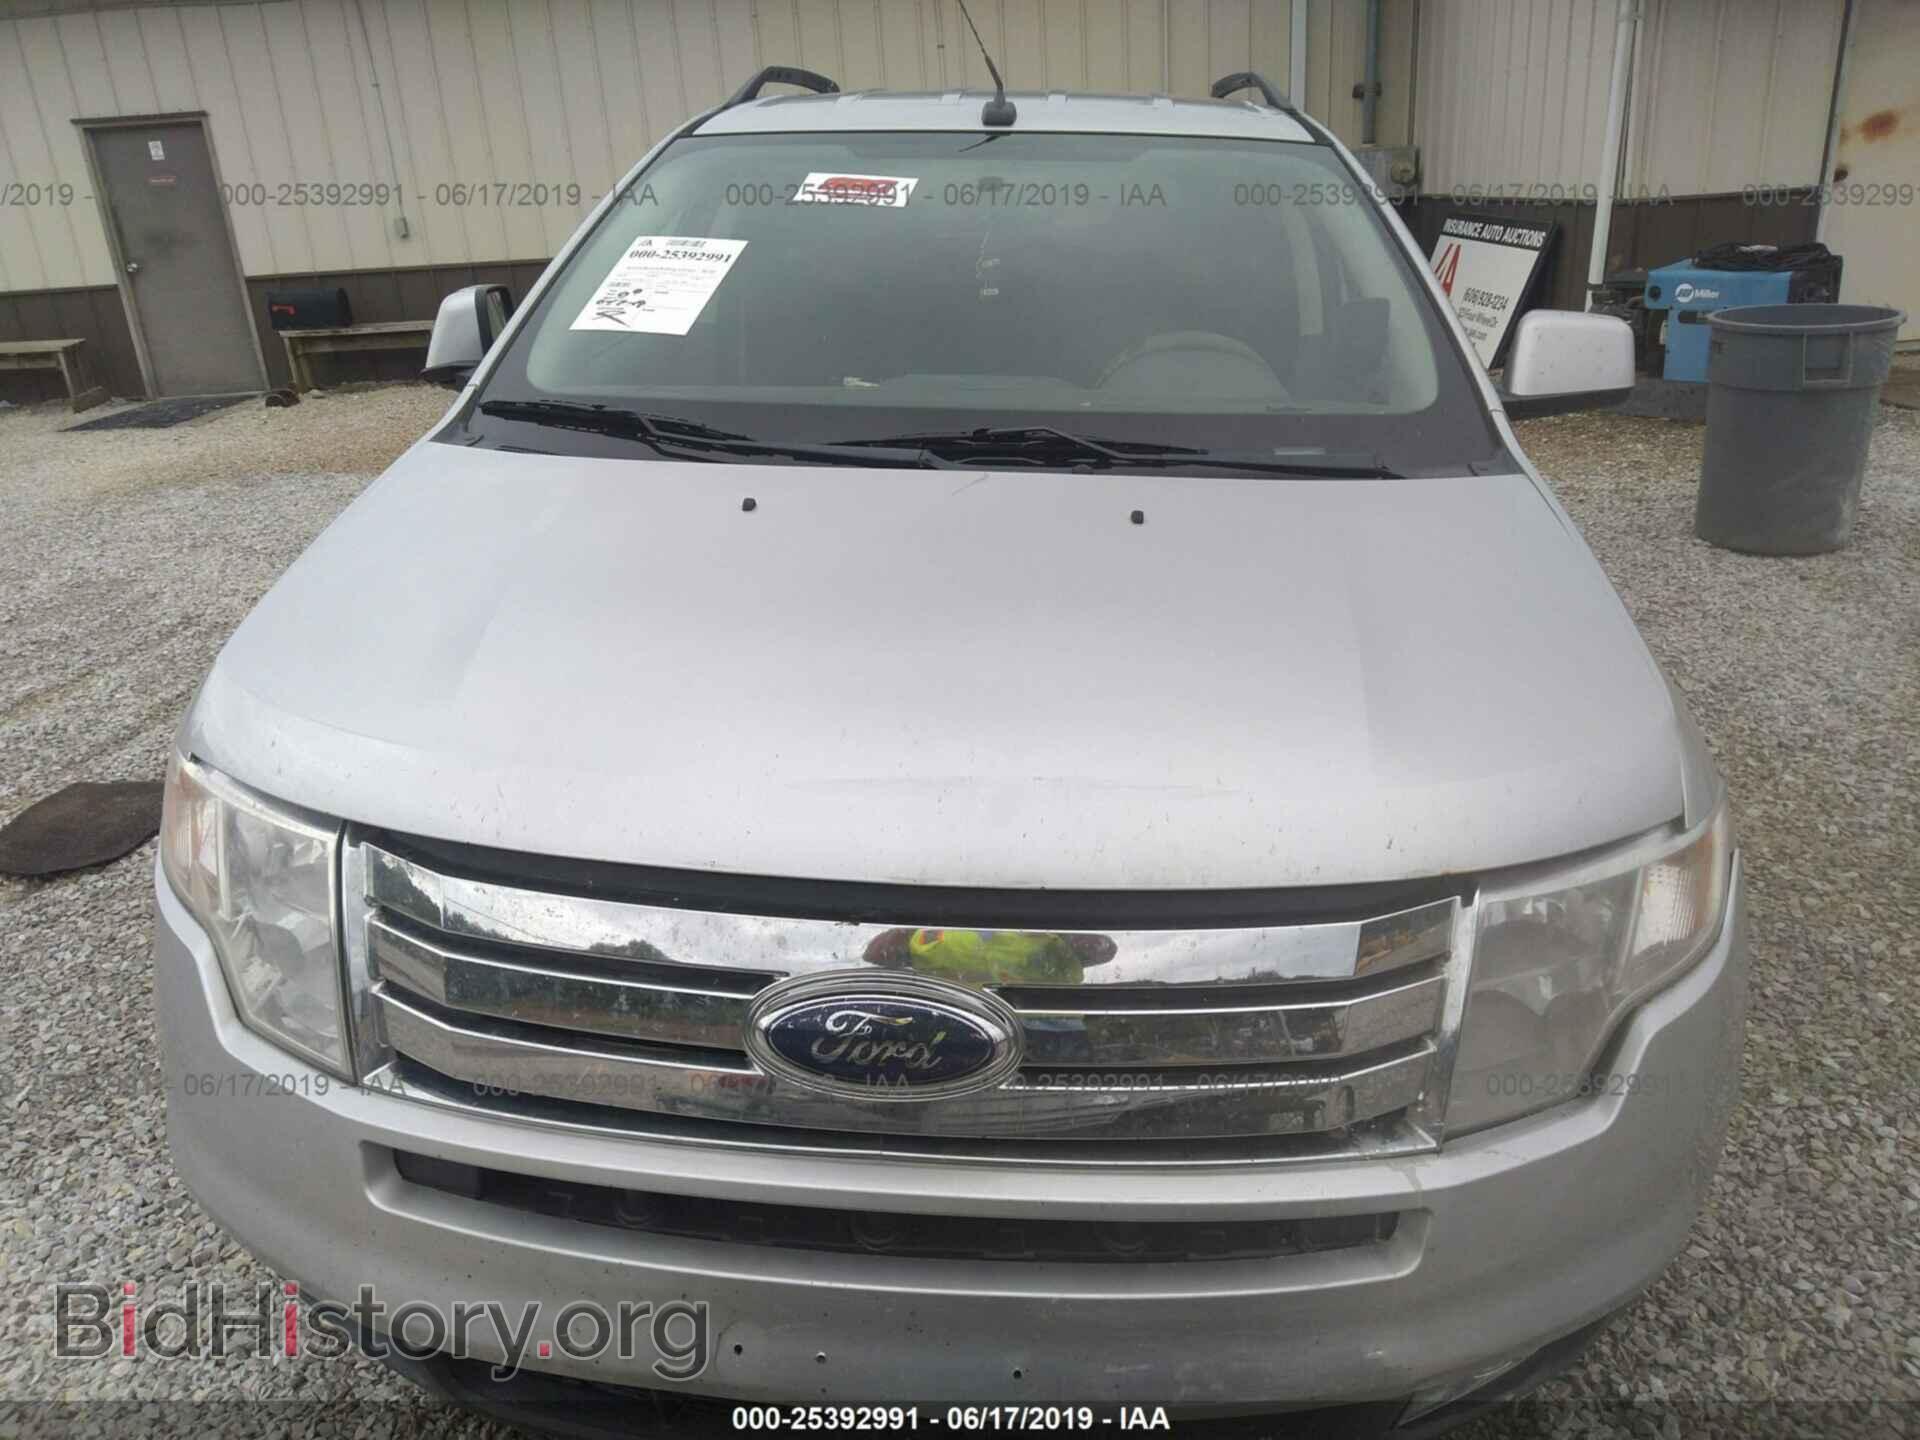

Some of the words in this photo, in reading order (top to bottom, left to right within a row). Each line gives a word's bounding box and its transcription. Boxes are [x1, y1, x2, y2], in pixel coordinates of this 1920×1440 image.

[1443, 218, 1483, 238] INSURANCE
[1480, 224, 1504, 242] AUTO
[1502, 227, 1546, 248] AUCTIONS
[629, 249, 733, 263] 000-25392991
[1694, 288, 1720, 299] Miller
[811, 1009, 945, 1069] Ford
